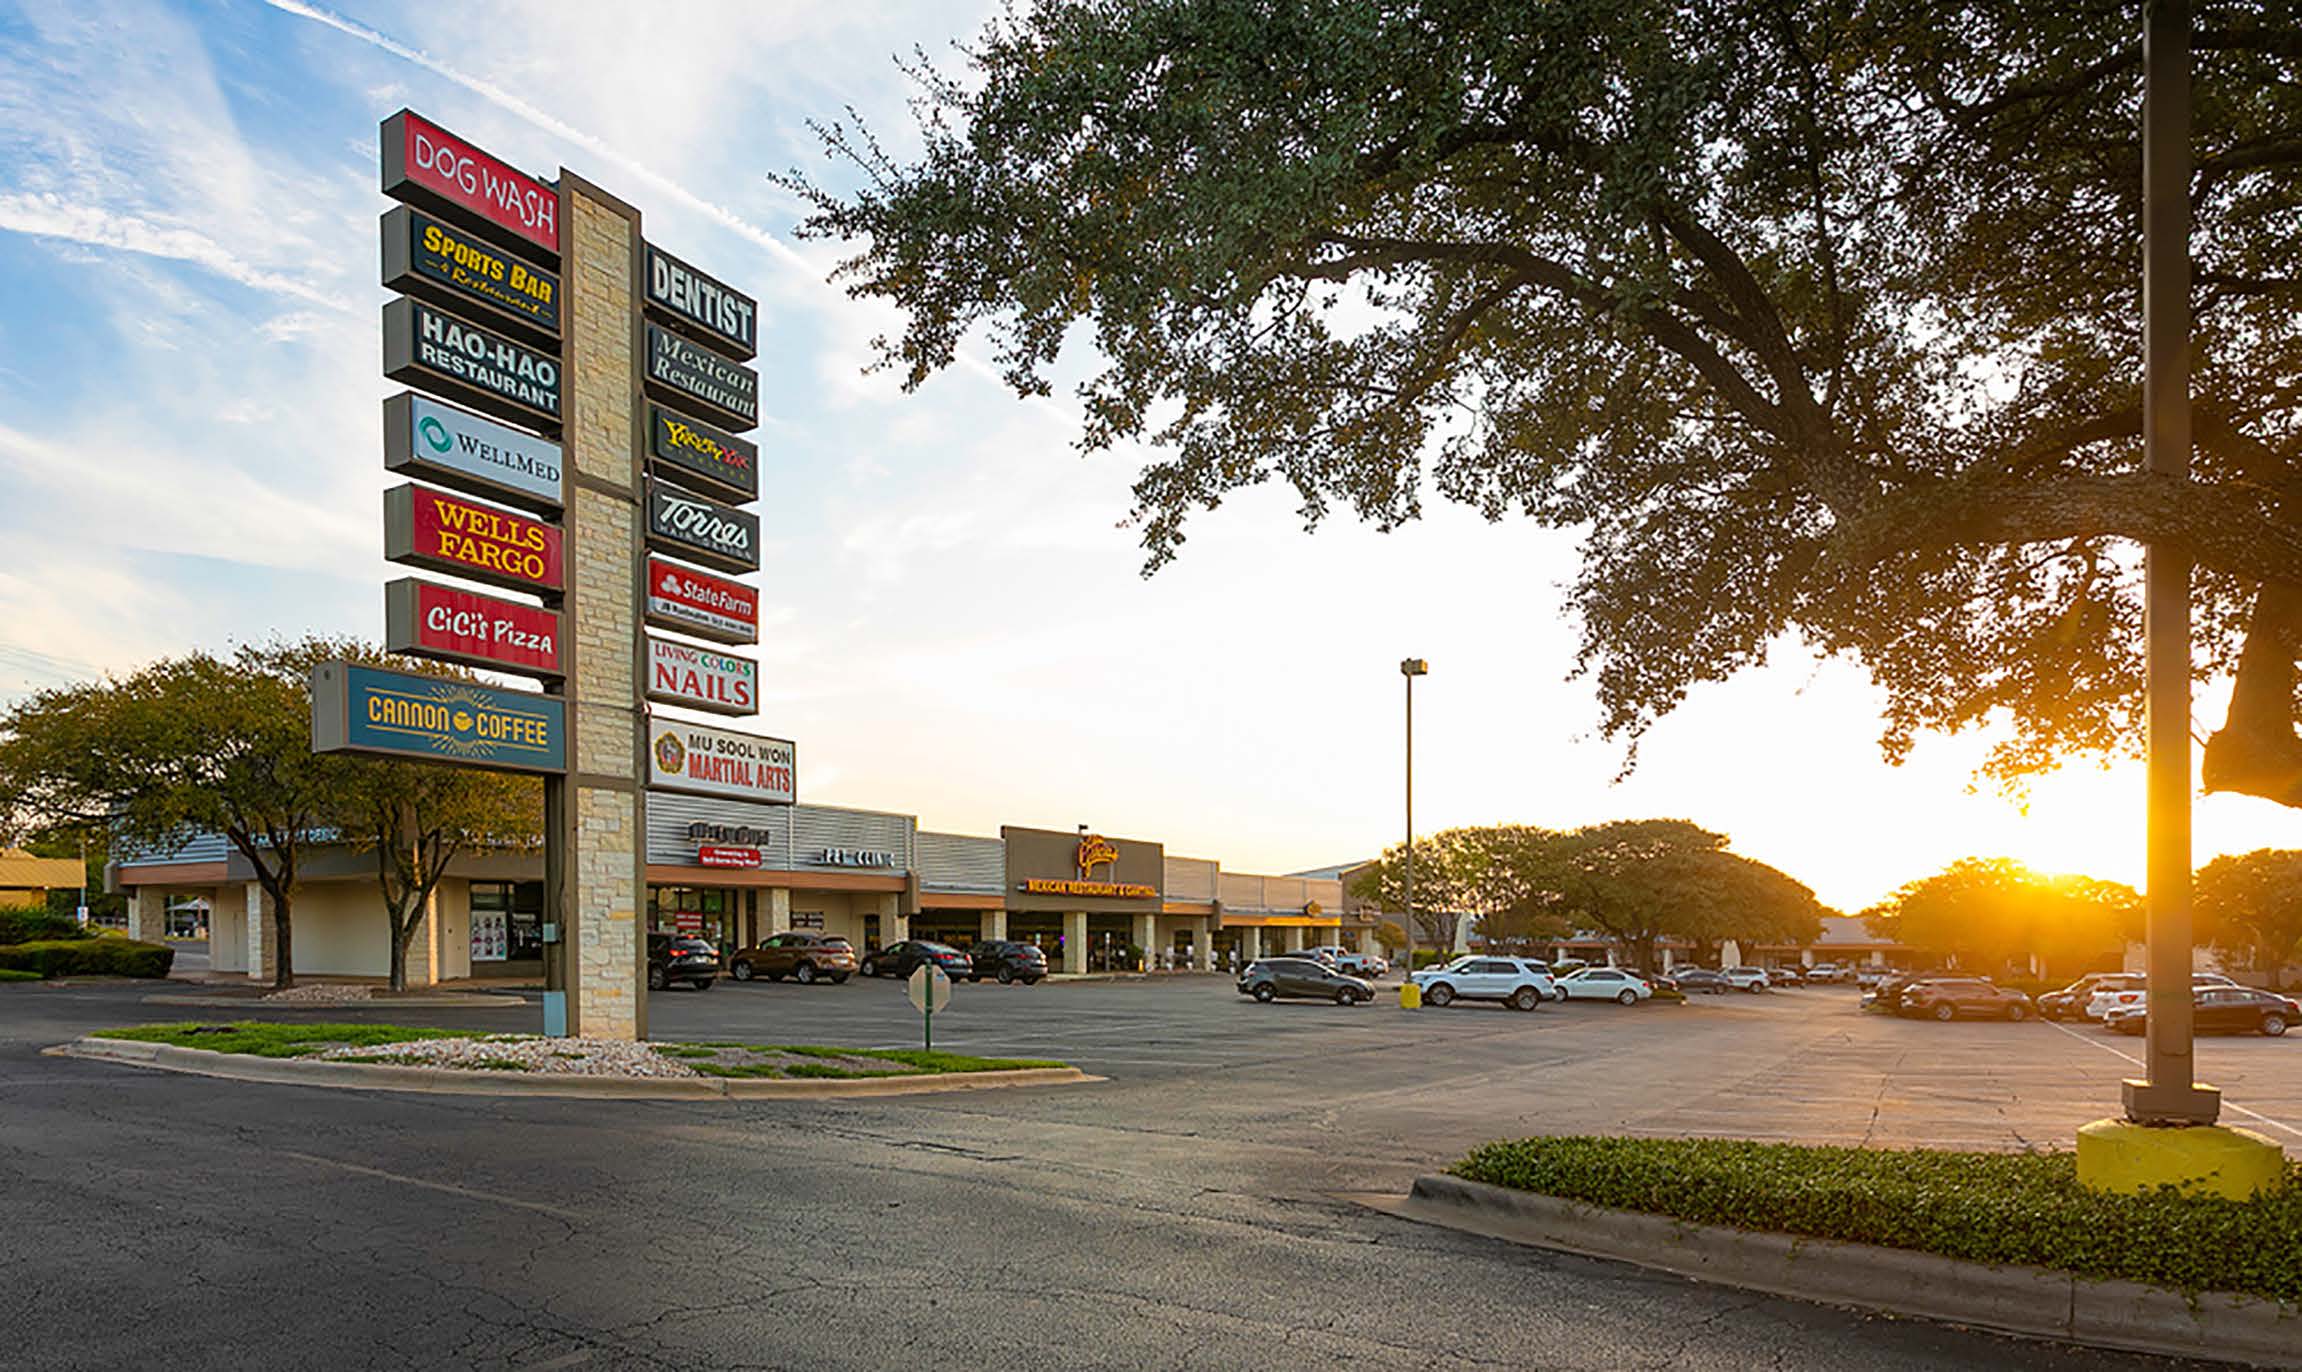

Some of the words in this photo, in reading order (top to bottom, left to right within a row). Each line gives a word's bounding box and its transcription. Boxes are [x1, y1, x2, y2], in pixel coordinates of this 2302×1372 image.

[415, 134, 477, 194] DOG
[483, 166, 555, 233] WASH
[423, 224, 505, 281] SPORTS
[510, 266, 553, 303] BAR
[654, 254, 752, 342] DENTIST
[421, 341, 558, 410] RESTAURANT
[422, 311, 557, 386] HAO-HAO
[657, 333, 754, 393] Mexican
[653, 355, 756, 418] Restaurant
[434, 499, 546, 551] WELLS
[659, 493, 749, 550] Torres
[437, 530, 545, 579] FARGO
[655, 642, 698, 664] LIVING
[701, 654, 751, 677] COLORS
[655, 662, 750, 707] NAILS
[367, 695, 449, 732] CANNON
[476, 711, 548, 746] COFFEE
[688, 733, 712, 751] MU
[717, 738, 755, 759] SOOL
[759, 745, 791, 765] WON
[688, 753, 753, 788] MARTIAL
[757, 763, 791, 793] ARTS
